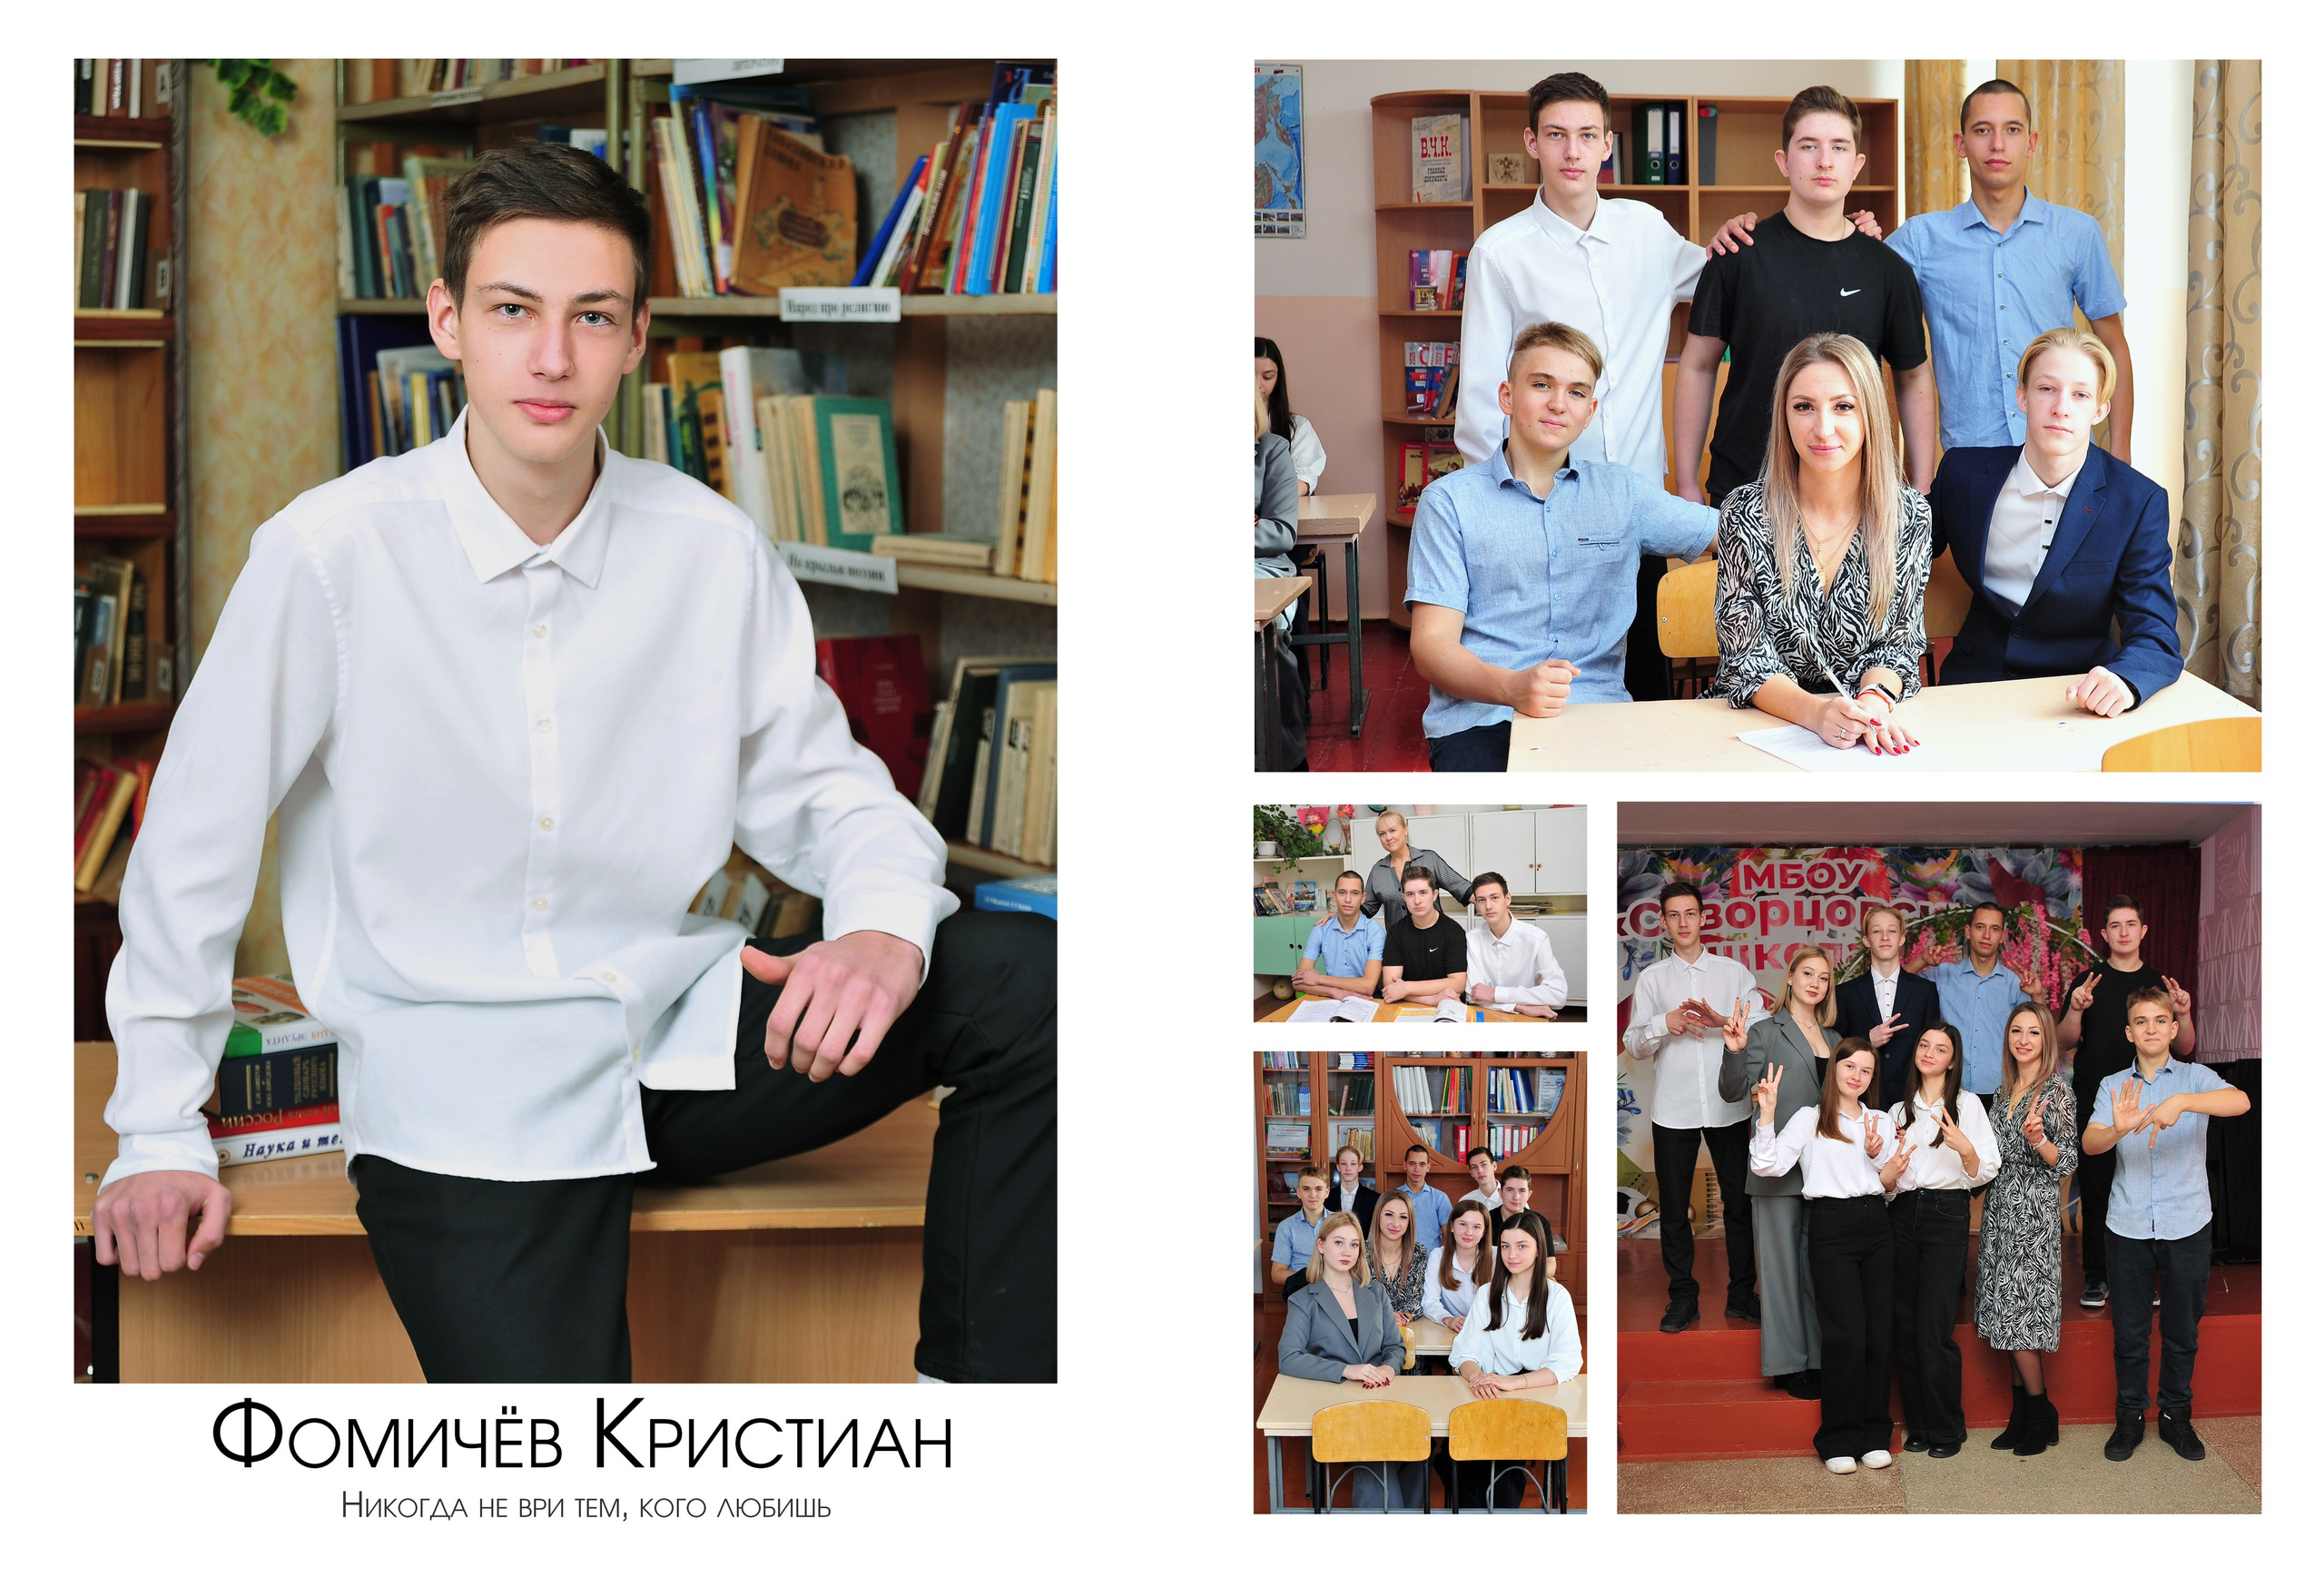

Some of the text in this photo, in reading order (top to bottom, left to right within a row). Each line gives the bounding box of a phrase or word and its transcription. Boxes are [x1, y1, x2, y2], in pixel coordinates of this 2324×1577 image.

[1421, 135, 1452, 158] В.Ч.К.
[842, 301, 891, 317] религию
[1744, 861, 1864, 891] МБОУ
[292, 1055, 301, 1105] ТОЛКОВЫЙ
[301, 1060, 310, 1100] СЛОВАРЬ
[310, 1056, 318, 1100] РУССКОГО
[243, 1139, 295, 1159] Наука
[301, 1138, 311, 1148] и
